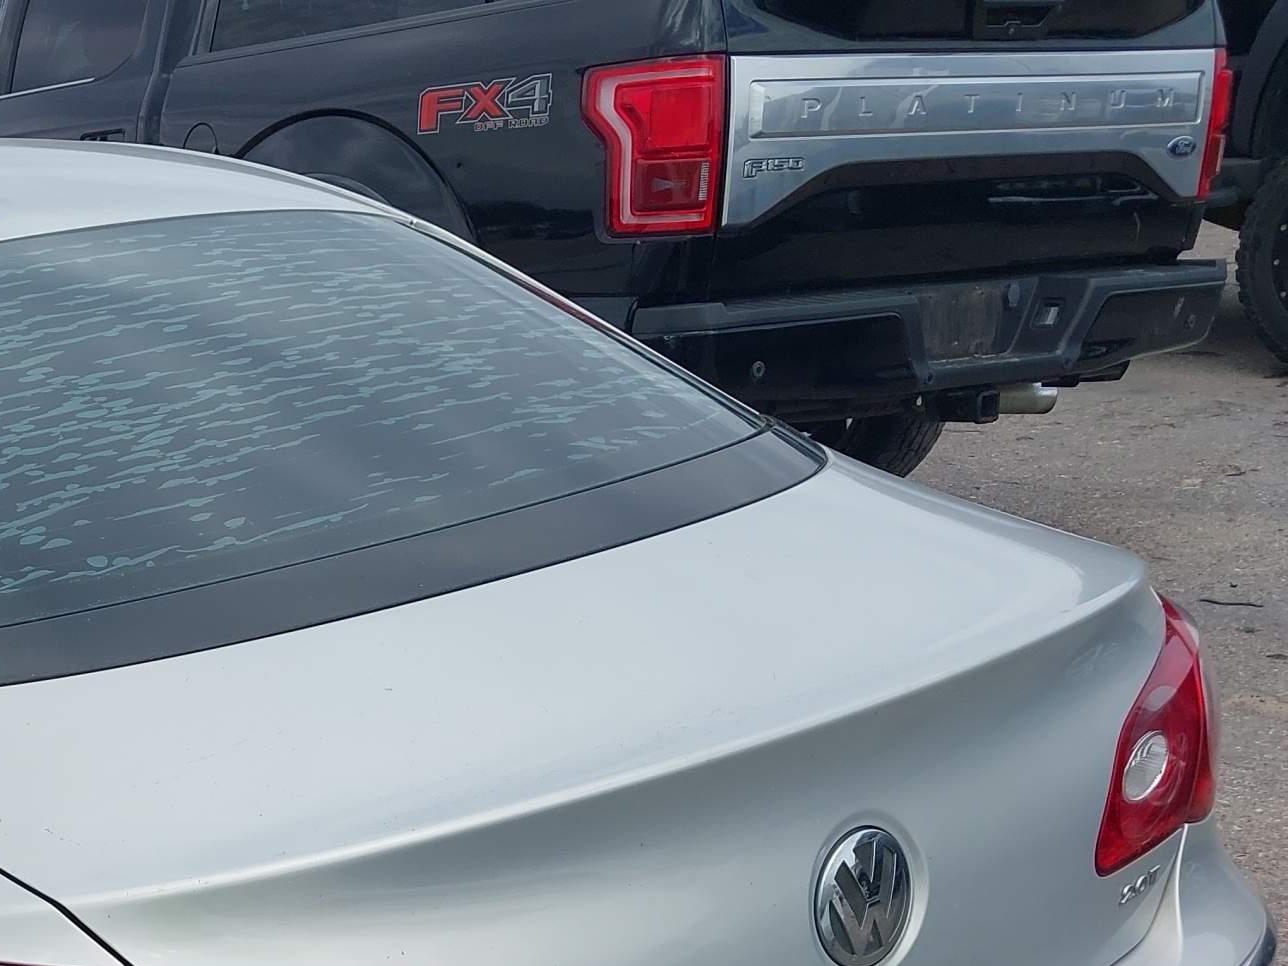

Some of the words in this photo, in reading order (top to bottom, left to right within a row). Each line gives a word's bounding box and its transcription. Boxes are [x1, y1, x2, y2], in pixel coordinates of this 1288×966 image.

[417, 73, 552, 134] FX4
[800, 89, 1176, 118] PLATINUM
[474, 120, 504, 132] OFF
[508, 116, 550, 128] ROAD
